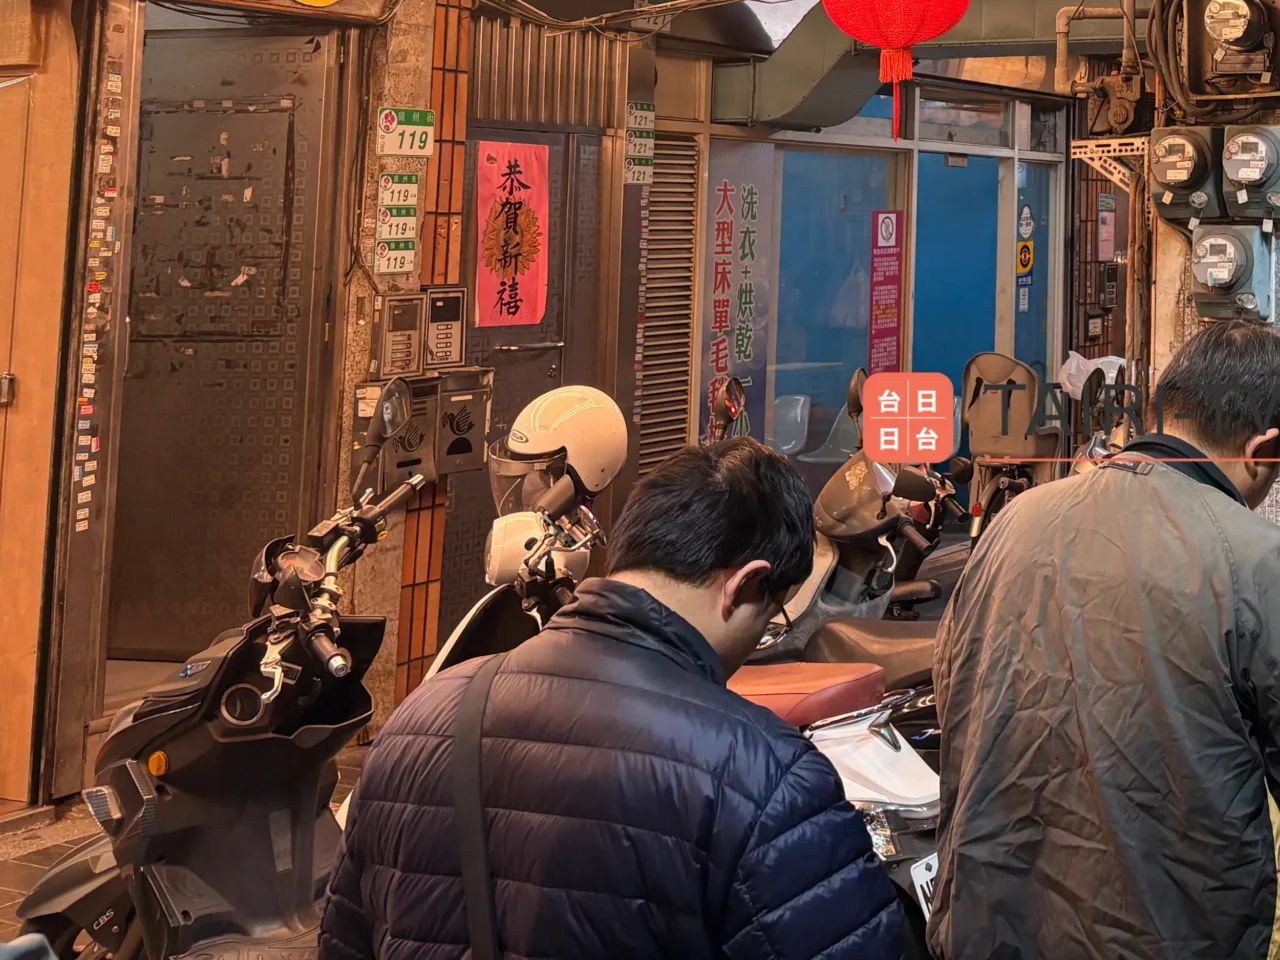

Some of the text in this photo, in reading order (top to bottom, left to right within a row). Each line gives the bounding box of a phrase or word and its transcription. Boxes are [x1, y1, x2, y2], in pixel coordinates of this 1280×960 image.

[633, 114, 649, 127] 121
[397, 129, 430, 150] 119
[632, 142, 648, 155] 121
[630, 170, 647, 183] 121
[389, 189, 410, 203] 119
[387, 222, 408, 237] 119
[493, 159, 532, 317] 恭賀新禧
[385, 256, 406, 270] 119
[93, 908, 114, 930] CBS
